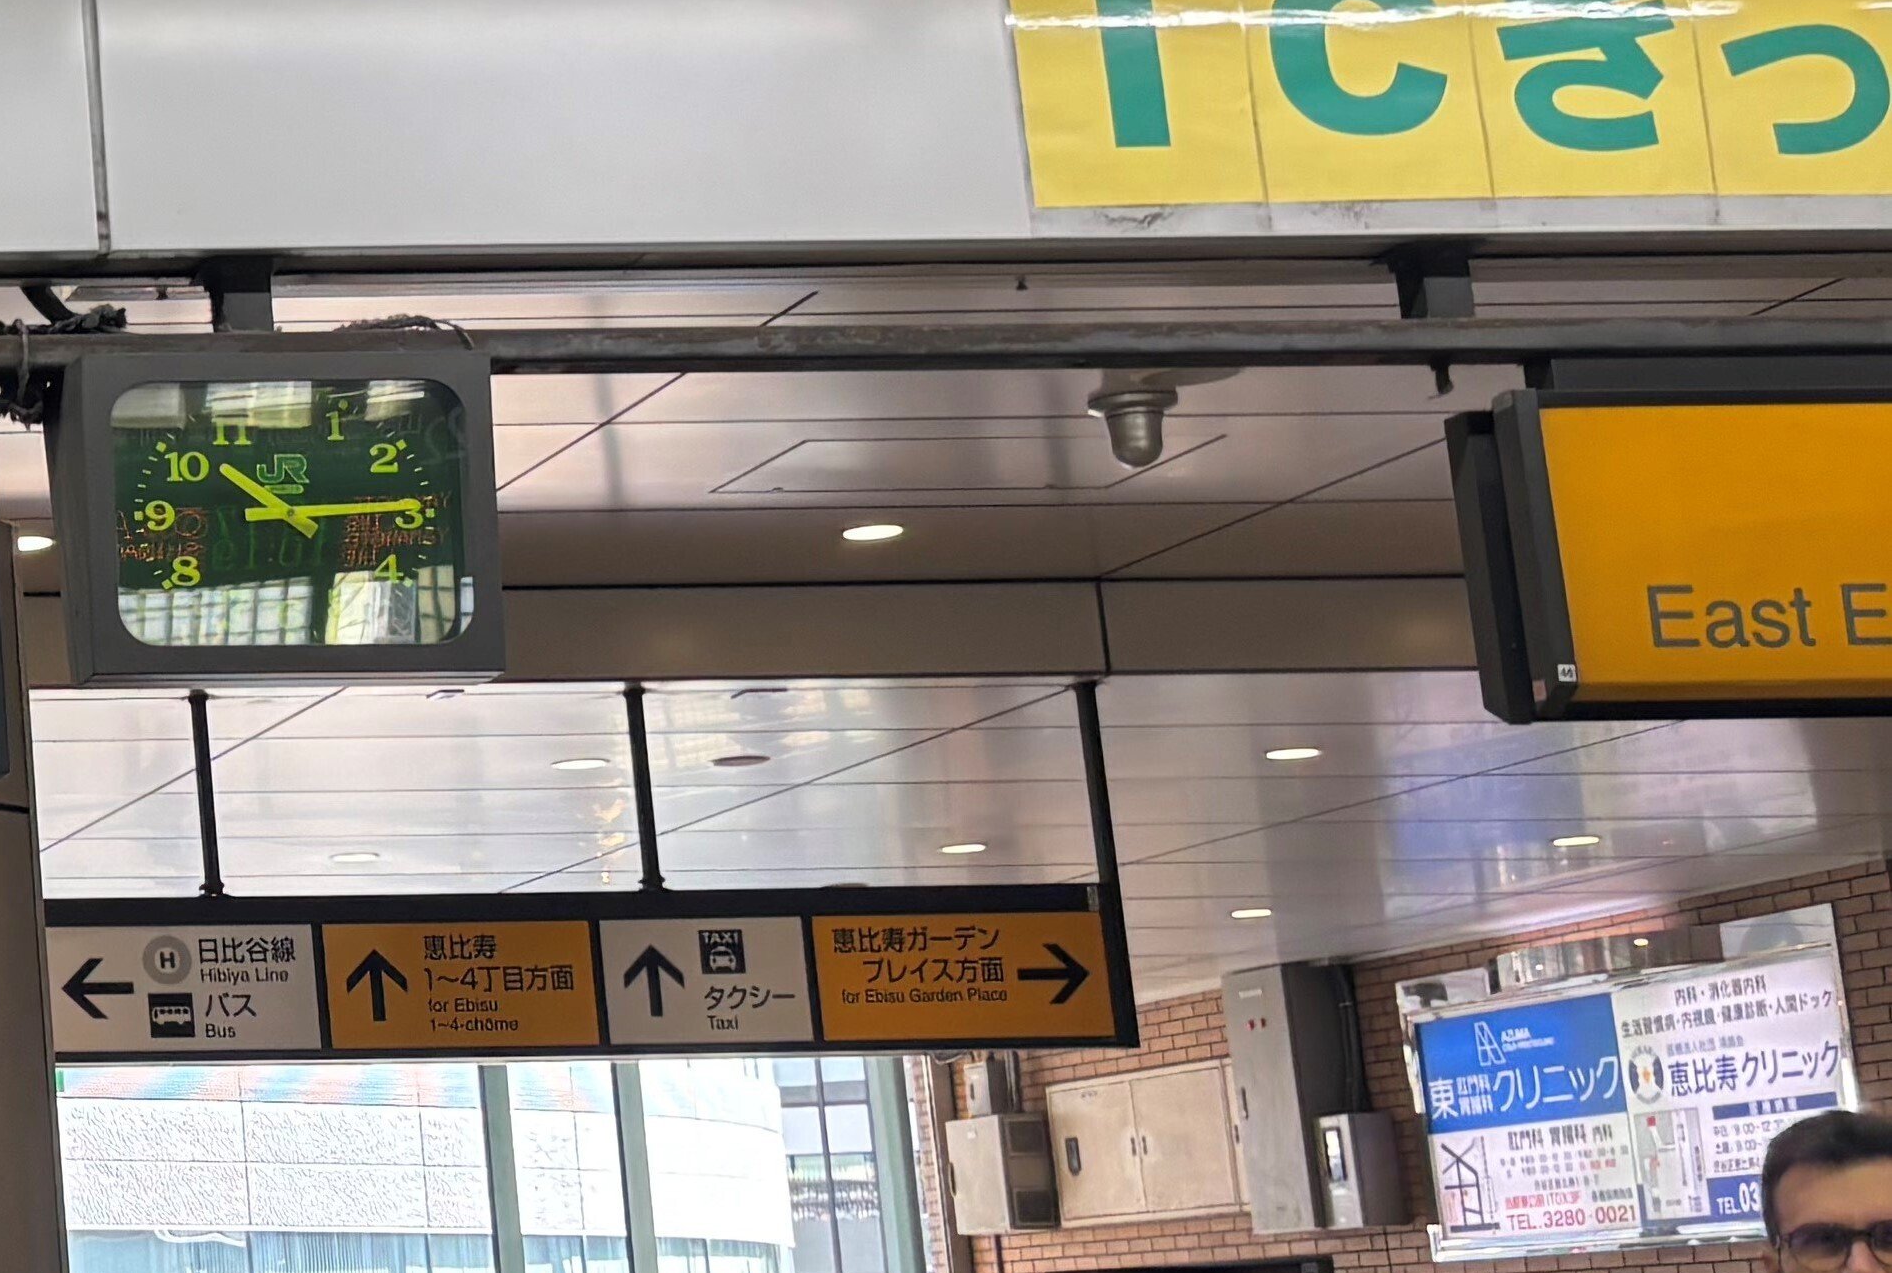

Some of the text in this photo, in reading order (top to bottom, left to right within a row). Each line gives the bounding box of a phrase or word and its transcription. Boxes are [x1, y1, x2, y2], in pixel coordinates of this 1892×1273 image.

[1647, 585, 1816, 649] East
[423, 934, 496, 960] 恵比寿
[704, 930, 740, 944] TAXI
[832, 927, 1000, 953] 恵比寿ガーデン
[198, 936, 295, 965] 日比谷線
[200, 966, 288, 985] Hibiya Line
[861, 958, 1004, 985] プレイス方面
[204, 992, 257, 1019] バス
[428, 997, 500, 1013] for Ebisu
[703, 986, 795, 1009] タクシー
[840, 986, 1007, 1005] for Ebisu Garden Place
[205, 1023, 236, 1038] Bus
[706, 1015, 737, 1031] Taxi
[1668, 1041, 1839, 1096] 恵比寿クリニック
